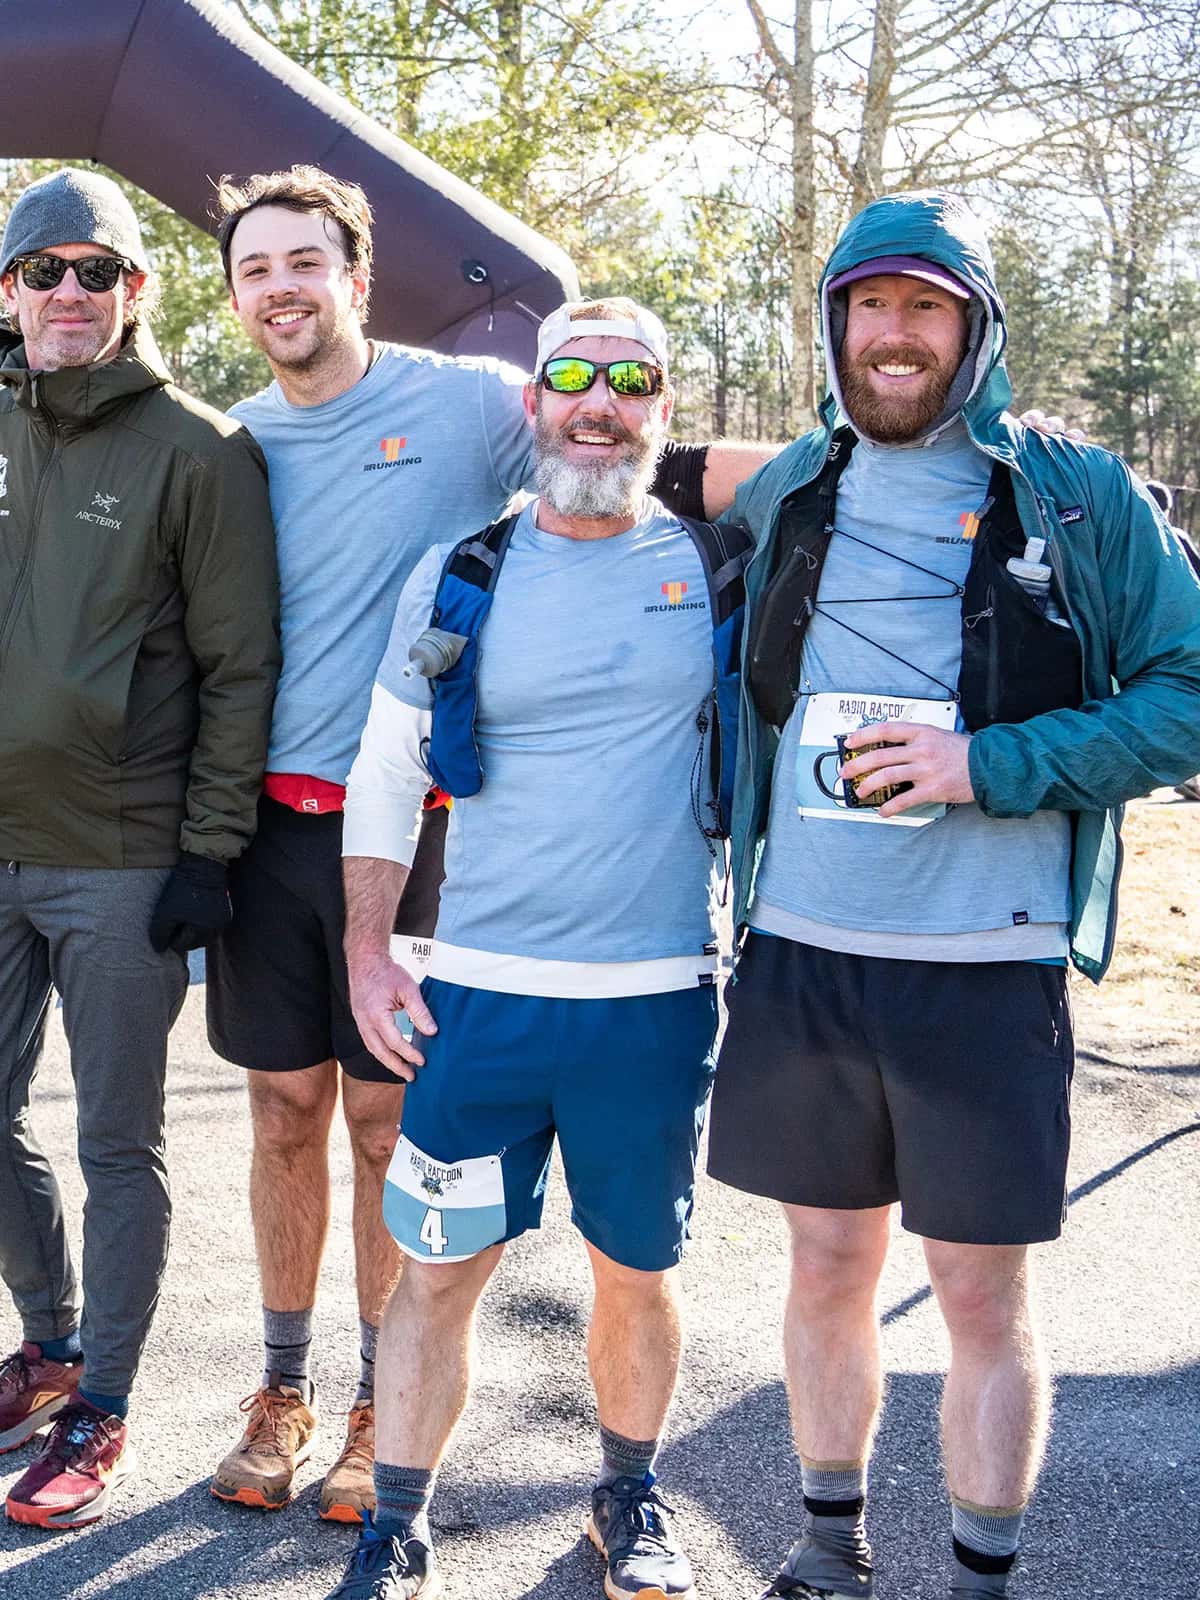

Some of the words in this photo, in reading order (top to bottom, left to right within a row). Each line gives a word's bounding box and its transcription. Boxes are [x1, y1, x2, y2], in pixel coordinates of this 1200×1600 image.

[370, 457, 422, 471] RUNNING
[652, 602, 706, 612] RUNNING
[428, 1163, 463, 1182] RACCOON
[420, 1208, 448, 1254] 4
